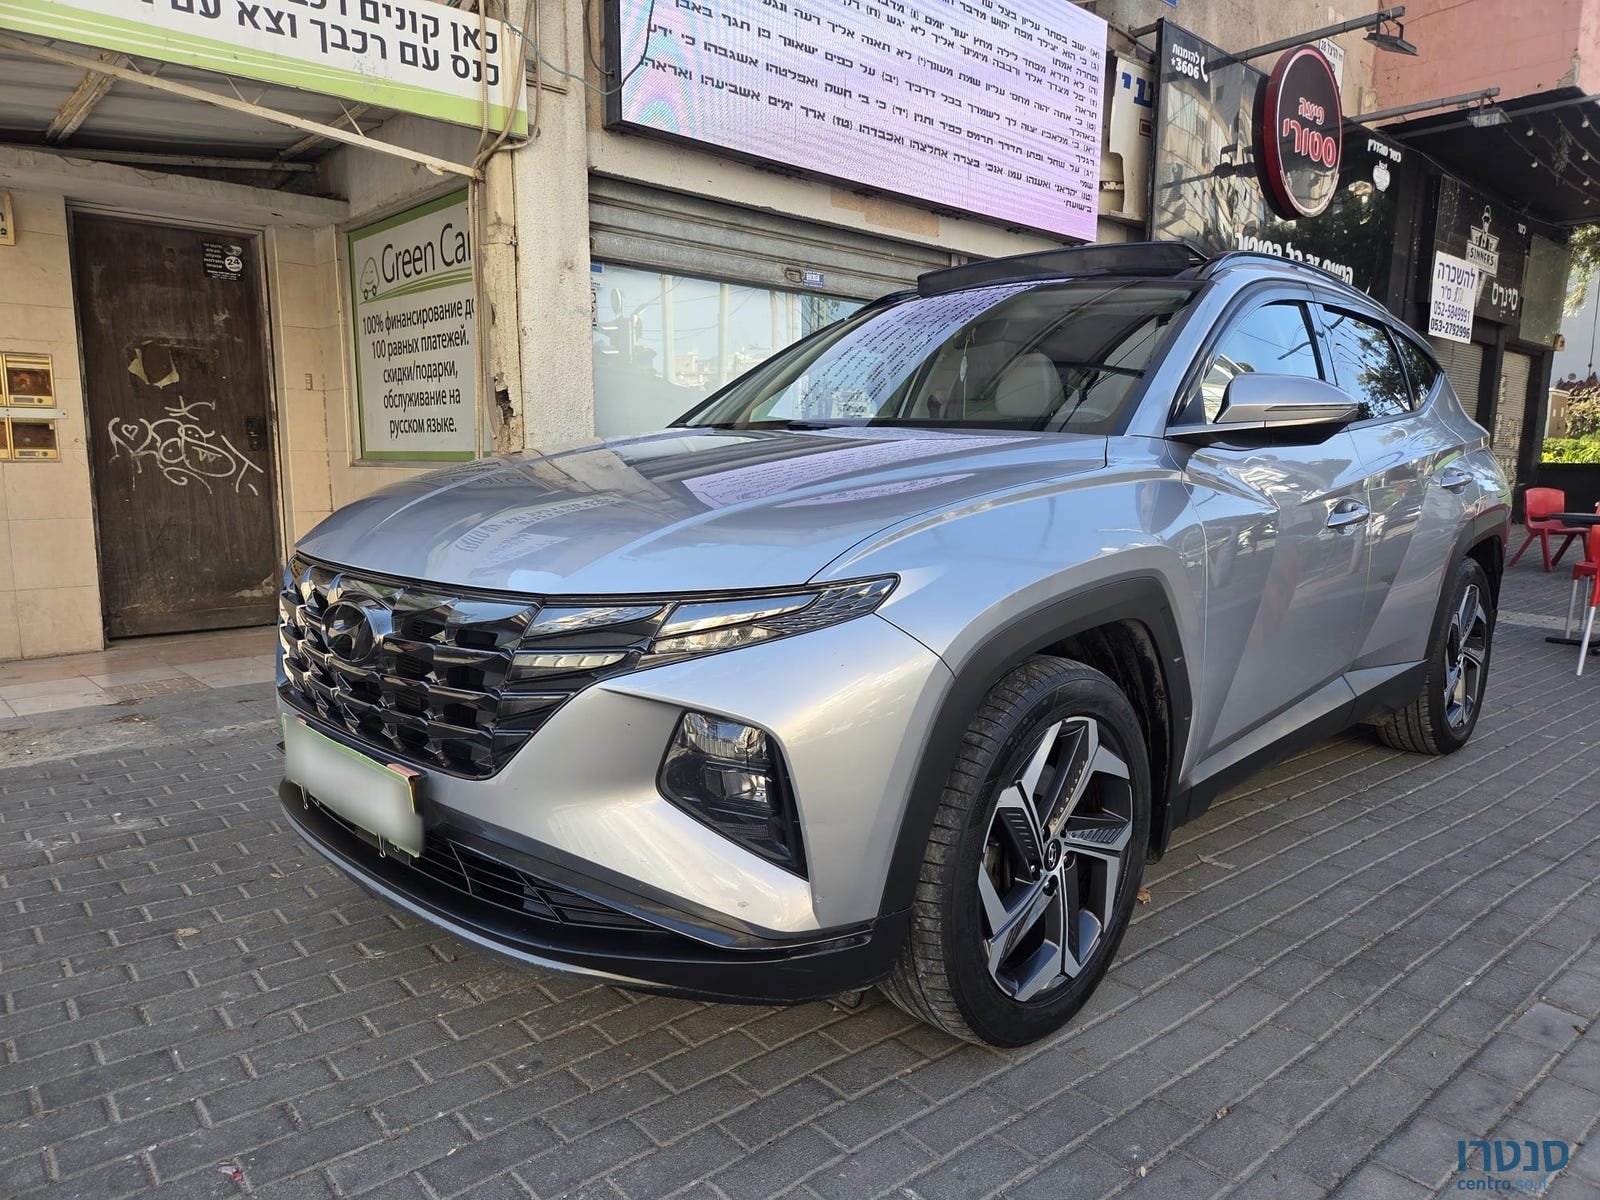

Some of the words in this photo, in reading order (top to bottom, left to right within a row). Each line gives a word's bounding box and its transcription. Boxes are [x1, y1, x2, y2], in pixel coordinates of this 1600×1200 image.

[793, 7, 820, 26] רעה
[958, 0, 986, 20] מדבר
[997, 3, 1017, 20] בצל
[237, 1, 298, 39] וצא
[360, 0, 440, 45] קונים
[720, 12, 750, 32] תגף
[886, 13, 905, 27] יגש
[924, 14, 944, 29] יומם
[990, 15, 1010, 30] יקוש
[1021, 16, 1040, 31] עליון
[757, 26, 771, 39] פן
[826, 20, 855, 39] אליך
[909, 24, 926, 36] לא
[949, 25, 969, 39] יעוף
[1013, 26, 1033, 41] מפח
[1043, 26, 1067, 44] בסתר
[309, 19, 388, 60] רכבך
[450, 21, 498, 55] כאן
[680, 32, 696, 46] כי
[777, 33, 818, 55] ישאונך
[860, 33, 890, 52] תאנה
[930, 32, 955, 49] אליך
[972, 35, 993, 51] מחץ
[1036, 36, 1058, 51] יצילך
[1071, 39, 1086, 51] ישב
[399, 41, 440, 71] עם
[703, 40, 758, 67] אשגבהו
[824, 50, 853, 68] כפים
[895, 47, 912, 60] לא
[959, 44, 988, 63] מימינך
[996, 46, 1018, 61] לילה
[1061, 48, 1076, 60] הוא
[1079, 56, 1087, 65] כי
[1172, 43, 1200, 64] להזמנות
[450, 54, 499, 87] כנס
[858, 62, 876, 76] על
[991, 57, 1020, 76] ורבבה
[1021, 56, 1046, 74] מפחד
[1051, 56, 1072, 71] אמתו
[765, 61, 818, 88] ואפלטהו
[957, 71, 981, 87] שמת
[1024, 71, 1042, 85] אלף
[1049, 69, 1069, 83] תירא
[1075, 67, 1099, 83] וסחרה
[700, 73, 760, 101] אשביעהו
[824, 82, 852, 99] חשק
[904, 79, 936, 98] דרכיך
[984, 82, 1005, 96] עליון
[1046, 80, 1069, 96] מצדך
[1072, 79, 1084, 89] לא
[767, 94, 793, 111] ימים
[857, 92, 870, 105] בי
[874, 98, 886, 110] כי
[940, 92, 962, 108] בכל
[1008, 91, 1030, 106] מחסי
[1072, 90, 1085, 102] יפל
[799, 104, 826, 121] ארך
[966, 102, 1000, 121] לשמרך
[1033, 101, 1050, 113] יהוה
[1052, 108, 1071, 121] אתה
[1074, 104, 1097, 119] תראה
[1298, 96, 1325, 125] פיצה
[913, 112, 934, 126] ותנין
[1004, 116, 1017, 126] לך
[1020, 121, 1038, 133] יצוה
[1074, 116, 1083, 126] כי
[858, 123, 904, 145] ואכבדהו
[938, 120, 962, 135] כפיר
[966, 129, 993, 145] תרמס
[1040, 129, 1068, 145] מלאכיו
[1071, 140, 1079, 149] כי
[1282, 117, 1336, 169] סטורי
[908, 138, 948, 158] אחלצהו
[997, 139, 1022, 155] תדרך
[1025, 149, 1043, 161] ופתן
[952, 152, 980, 168] בצרה
[1046, 155, 1065, 168] שחל
[1074, 153, 1095, 166] רגלך
[984, 162, 1003, 175] אנכי
[1006, 169, 1022, 180] עמו
[1068, 163, 1080, 173] על
[1025, 175, 1051, 189] ואענהו
[1054, 183, 1077, 196] יקראני
[1079, 179, 1093, 190] שמי
[1062, 199, 1092, 213] בישועתי
[381, 239, 436, 284] Green
[1437, 262, 1476, 289] להשכרה
[362, 312, 384, 336] 100%
[384, 298, 463, 333] финансирование
[371, 340, 386, 360] 100
[386, 337, 420, 362] равных
[420, 325, 470, 351] платежей.
[383, 360, 459, 386] скидки/подарки,
[383, 389, 446, 414] обслуживание
[449, 389, 461, 405] на
[389, 416, 425, 441] русском
[426, 414, 457, 433] языке.
